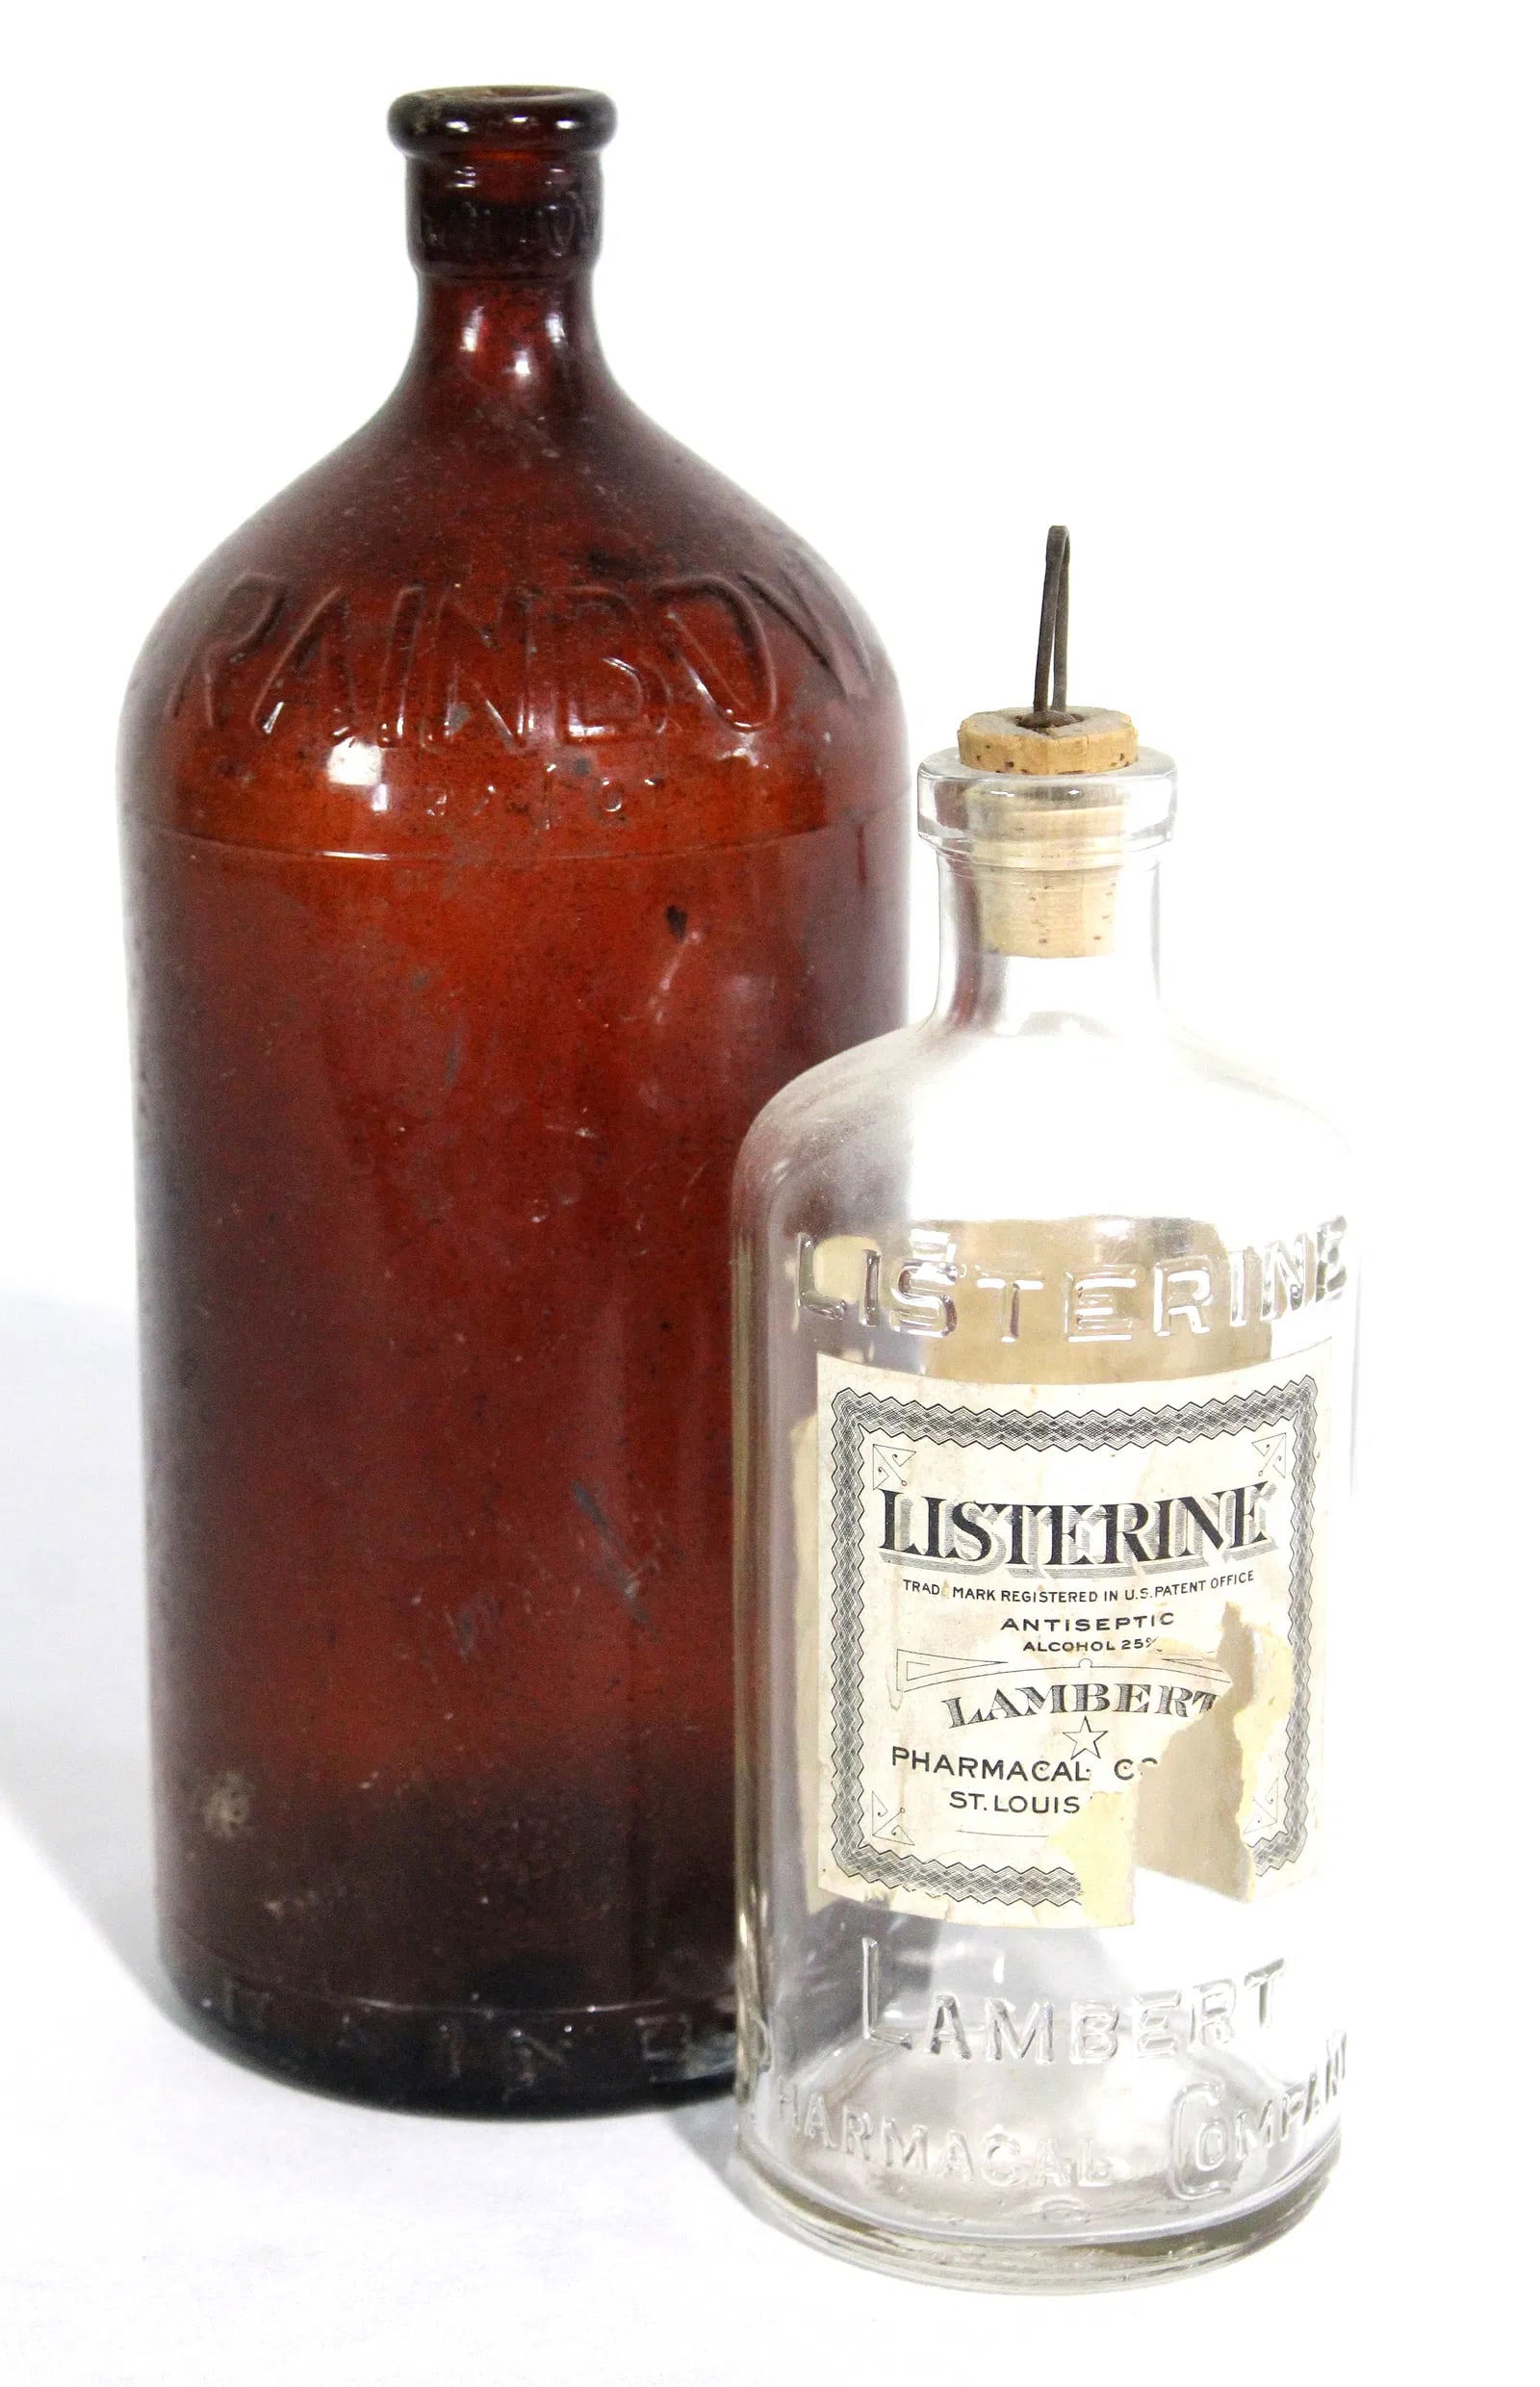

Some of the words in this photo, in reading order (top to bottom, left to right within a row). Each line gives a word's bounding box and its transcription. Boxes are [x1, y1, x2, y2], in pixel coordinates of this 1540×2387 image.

[795, 1215, 1348, 1342] LISTERINE
[877, 1480, 1276, 1575] LISTERINE
[903, 1578, 943, 1596] TRAD
[952, 1586, 995, 1602] MARK
[1001, 1590, 1098, 1603] REGISTERED
[1104, 1590, 1118, 1603] IN
[1154, 1579, 1206, 1598] PATENT
[1210, 1570, 1255, 1589] OFFICE
[1000, 1612, 1174, 1632] ANTISEPTIC
[1022, 1641, 1116, 1653] ALCOHOL
[940, 1682, 1220, 1730] LAMBERT
[891, 1747, 1091, 1783] PHARMACAL
[861, 1937, 1287, 2066] LAMBERT
[762, 2052, 1114, 2188] HARMACAL
[1168, 2027, 1348, 2201] COMPAN
